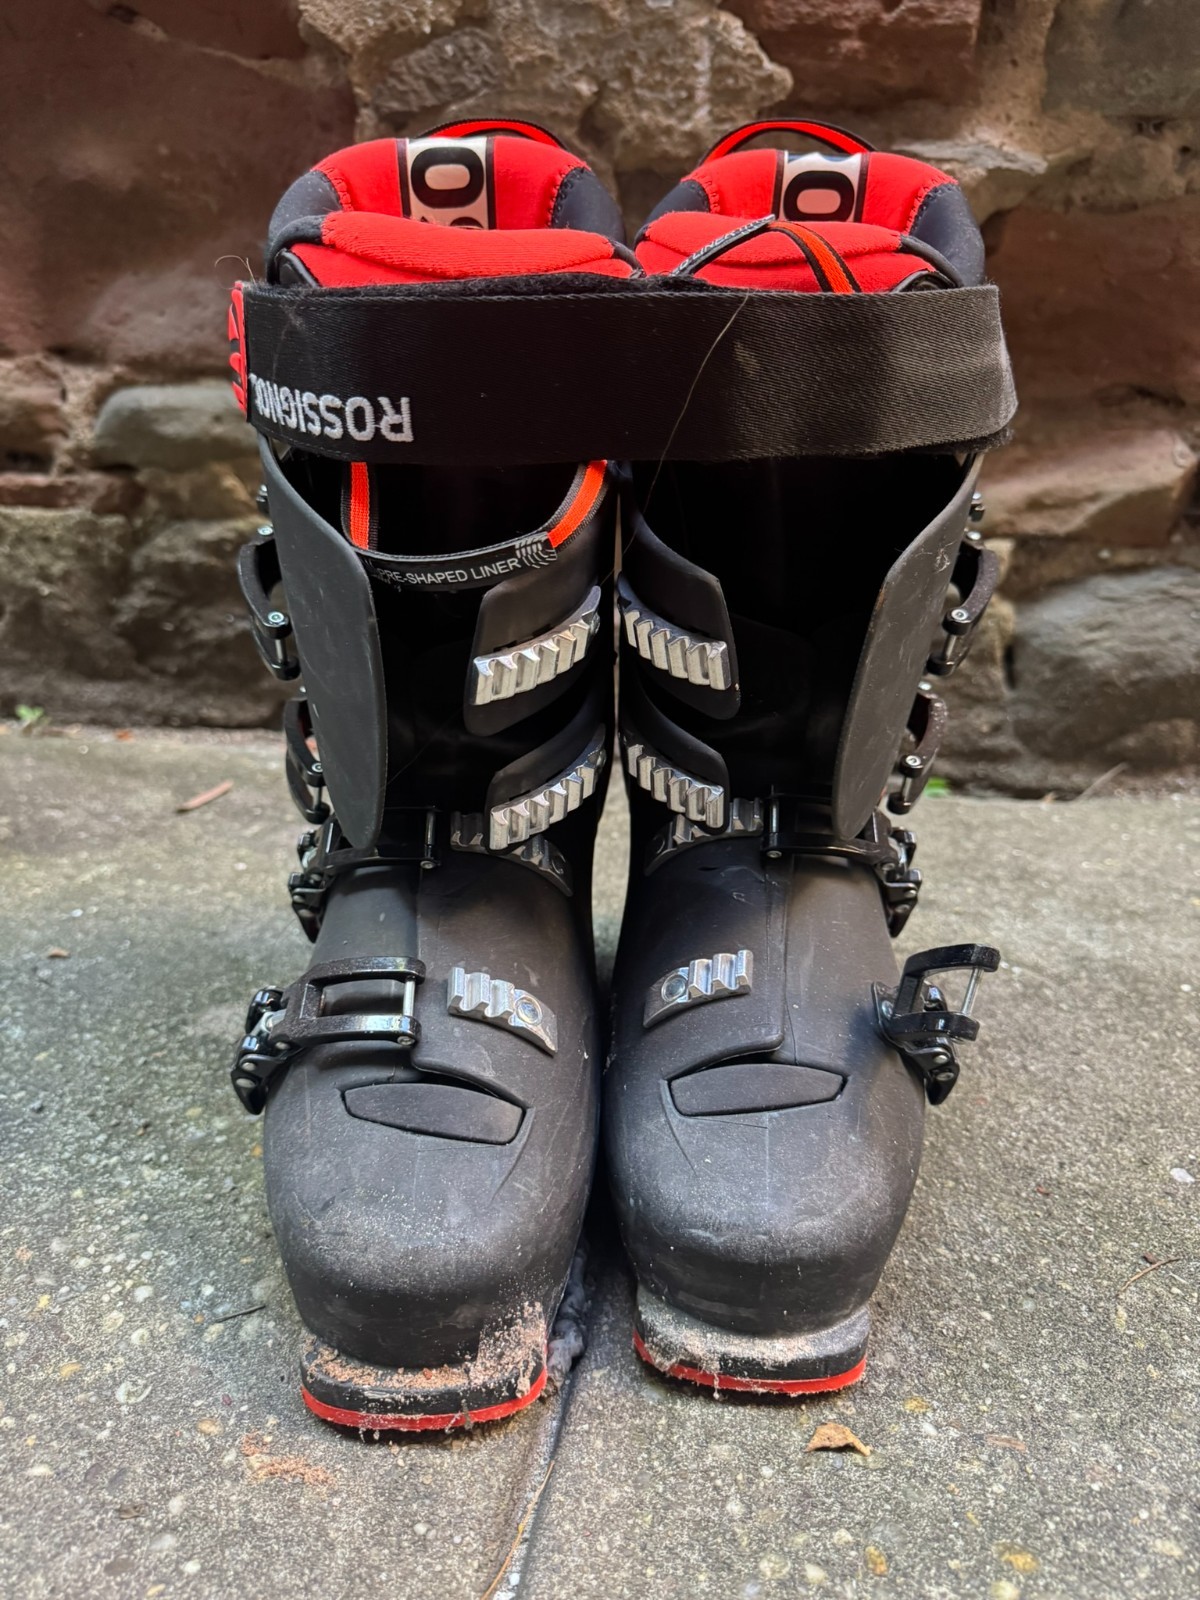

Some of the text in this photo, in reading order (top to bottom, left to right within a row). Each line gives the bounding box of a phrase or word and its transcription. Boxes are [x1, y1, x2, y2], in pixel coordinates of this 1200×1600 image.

[249, 373, 414, 442] ROSSIGNOL
[377, 557, 522, 585] PRE-SHAPED LINER
